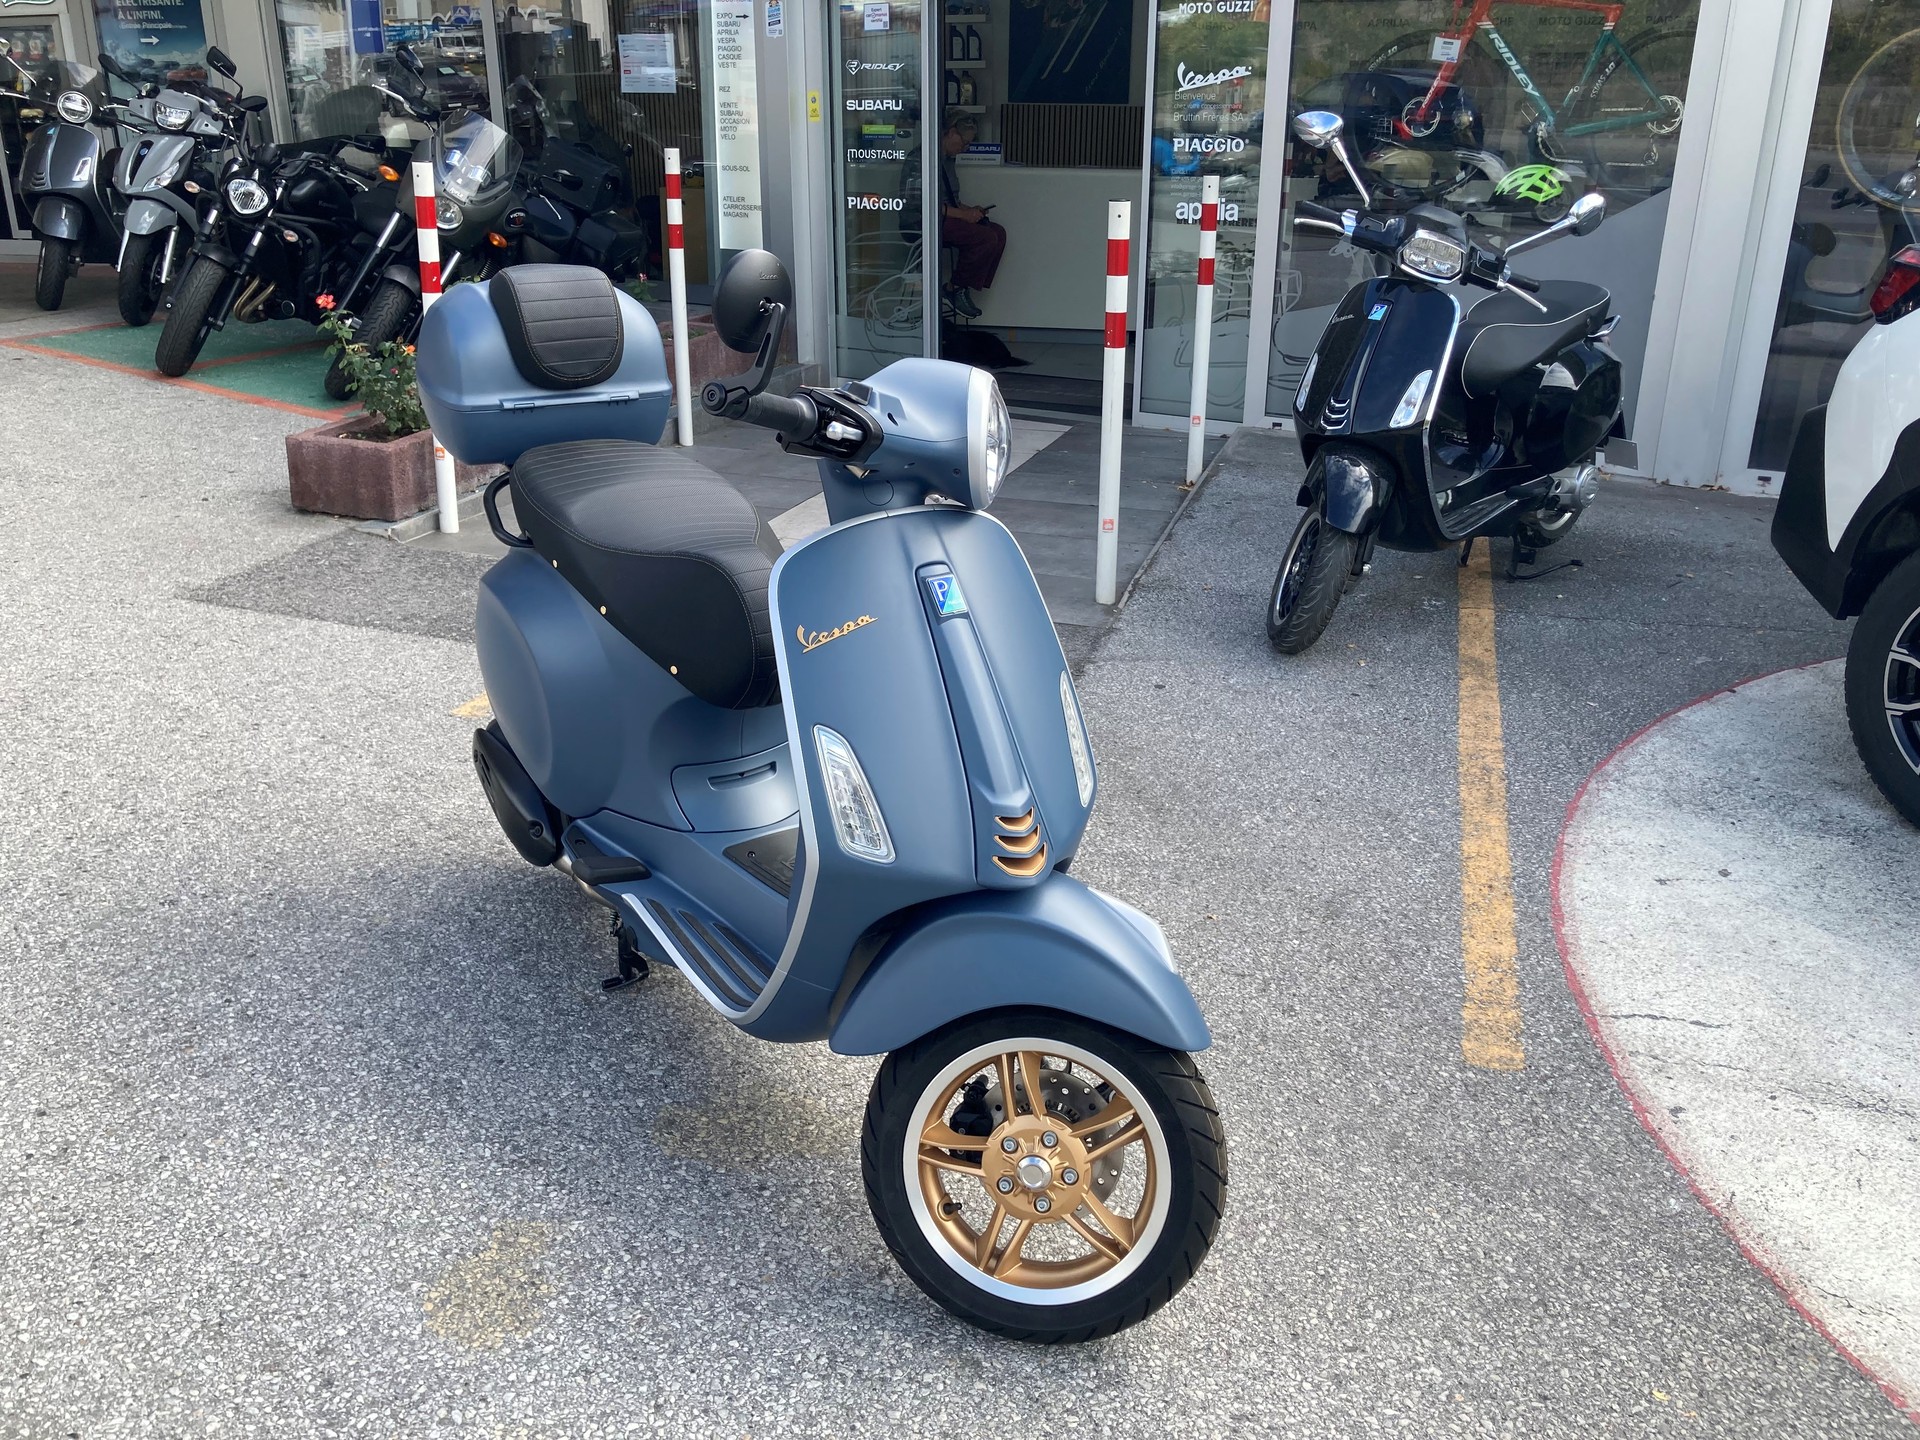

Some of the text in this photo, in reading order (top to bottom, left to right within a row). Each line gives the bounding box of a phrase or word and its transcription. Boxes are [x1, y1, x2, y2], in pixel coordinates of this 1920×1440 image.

[1179, 1, 1254, 14] MOTO GUZZI
[127, 10, 164, 20] L'INFINI.
[1367, 18, 1410, 28] APRILIA
[1538, 16, 1571, 26] MOTO
[1575, 16, 1606, 26] GUZZ
[861, 62, 905, 72] RIDLEY
[1488, 33, 1540, 97] RIDLEY
[1177, 62, 1252, 90] Vespa
[1590, 74, 1606, 99] SWISS
[1174, 91, 1216, 100] Bienvenue
[846, 99, 902, 111] SUBARU
[1173, 112, 1245, 122] Bruttin Frères SA
[1172, 138, 1246, 153] PIAGGIO
[847, 148, 905, 162] MOUSTACHE
[846, 196, 904, 211] PIAGGIO
[1175, 198, 1239, 224] aplia
[796, 615, 879, 654] Vespa
